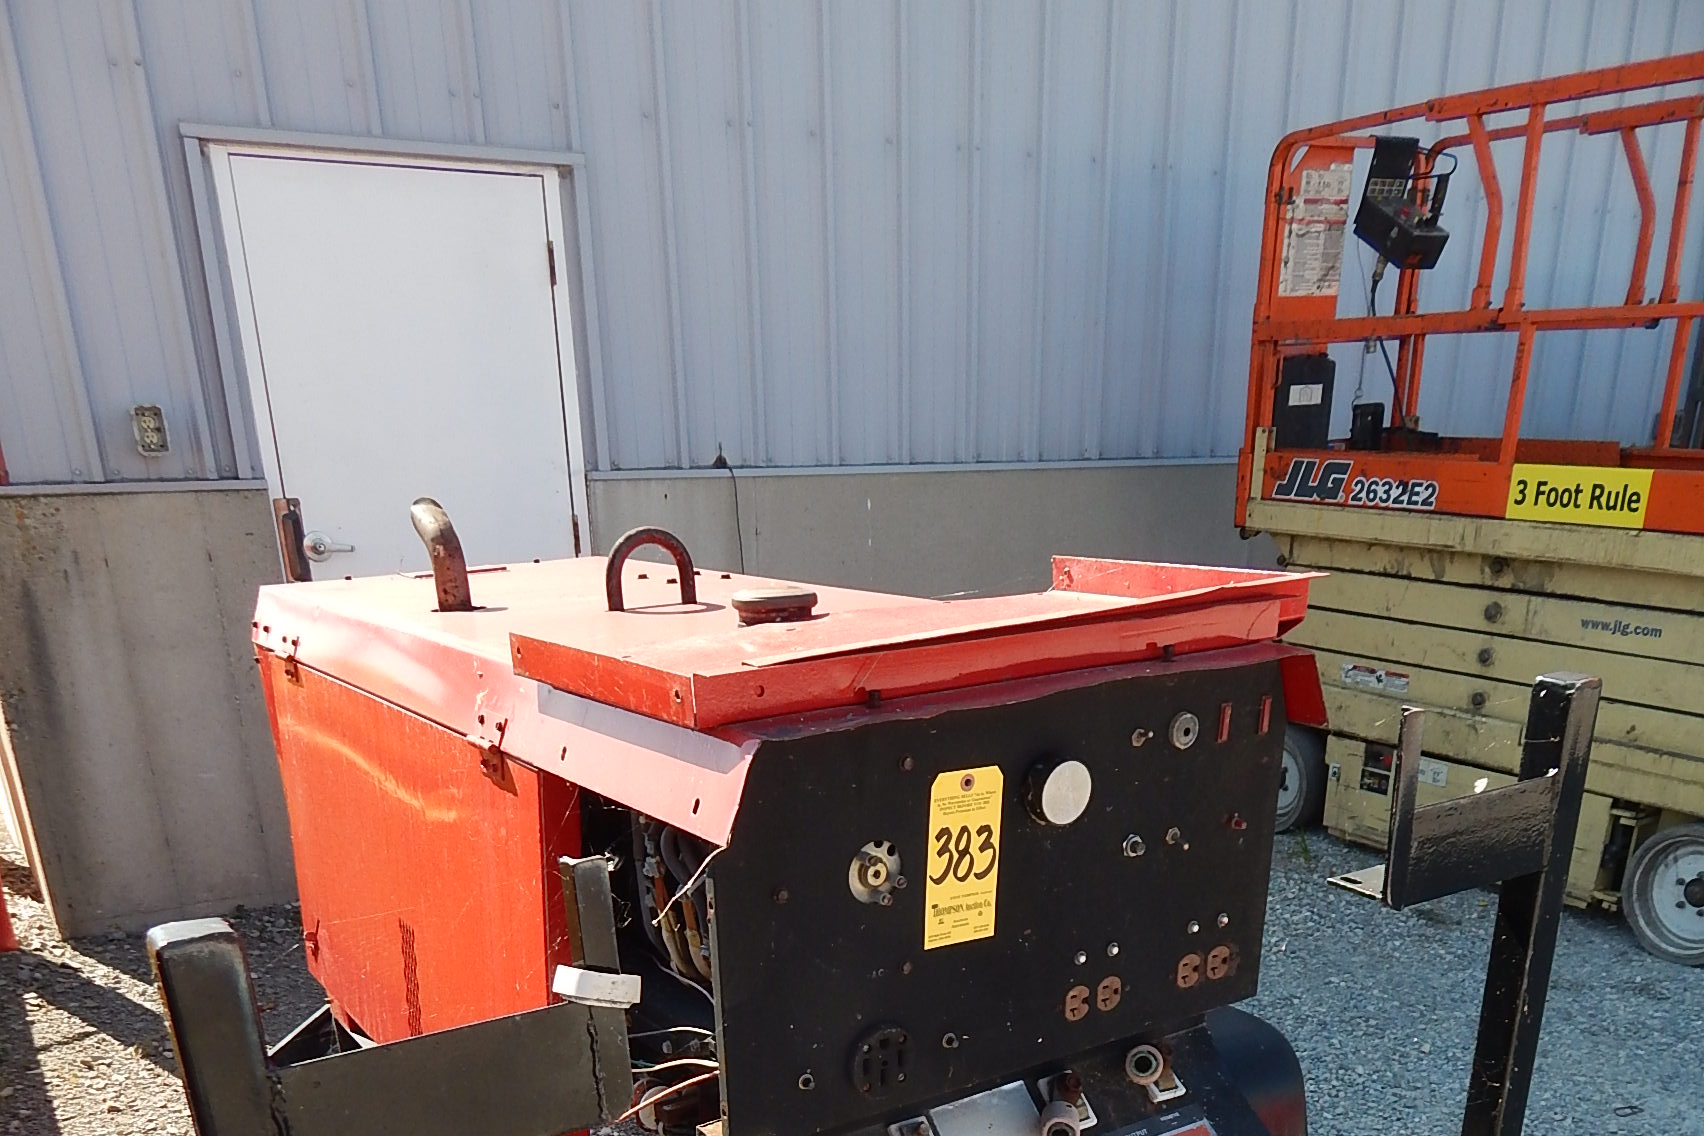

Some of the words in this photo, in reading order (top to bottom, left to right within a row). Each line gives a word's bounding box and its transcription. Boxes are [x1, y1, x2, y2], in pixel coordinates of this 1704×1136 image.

[1273, 459, 1353, 501] JLG
[1350, 478, 1438, 508] 2632E2
[1513, 479, 1528, 506] 3
[1533, 480, 1584, 509] Foot
[1588, 483, 1642, 513] Rule
[1580, 619, 1663, 638] www.jlg.com
[929, 824, 997, 886] 383
